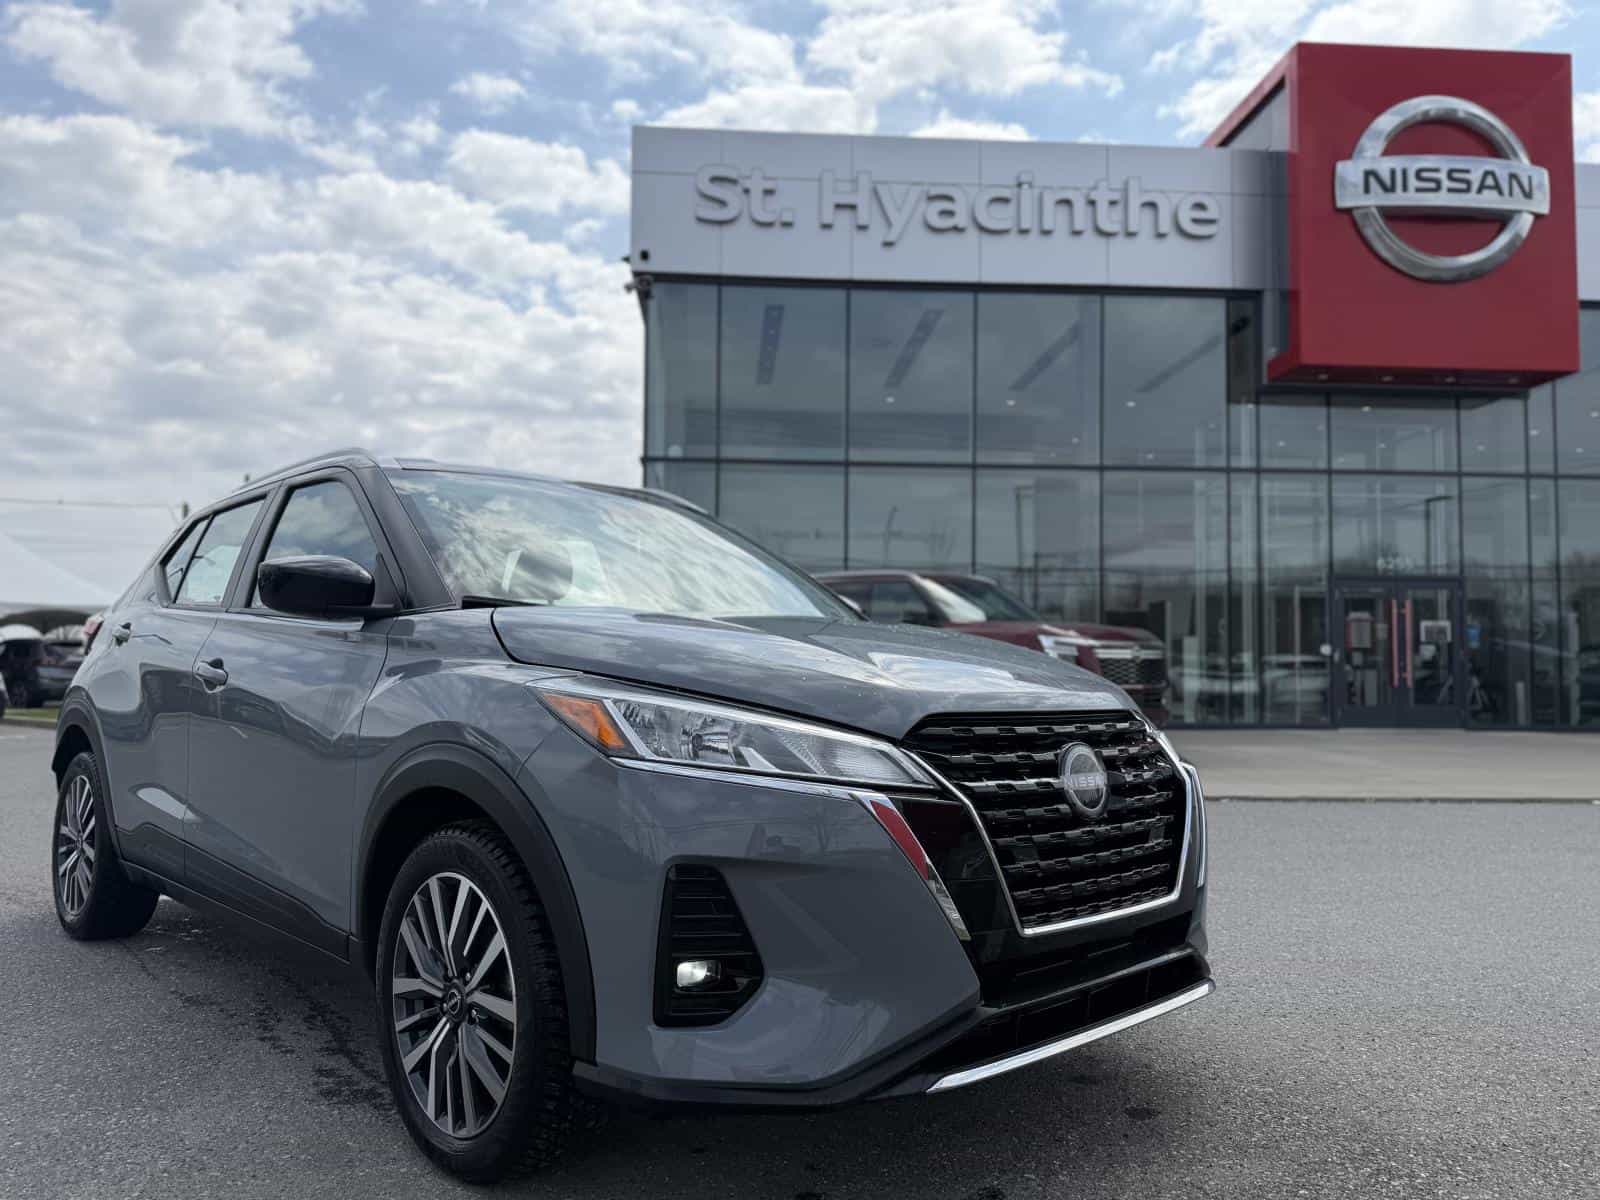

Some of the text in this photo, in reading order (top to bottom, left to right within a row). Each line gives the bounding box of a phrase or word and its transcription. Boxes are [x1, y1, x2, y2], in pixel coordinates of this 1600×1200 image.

[694, 164, 1222, 248] St. Hyacinthe
[1363, 167, 1534, 200] NISSAN
